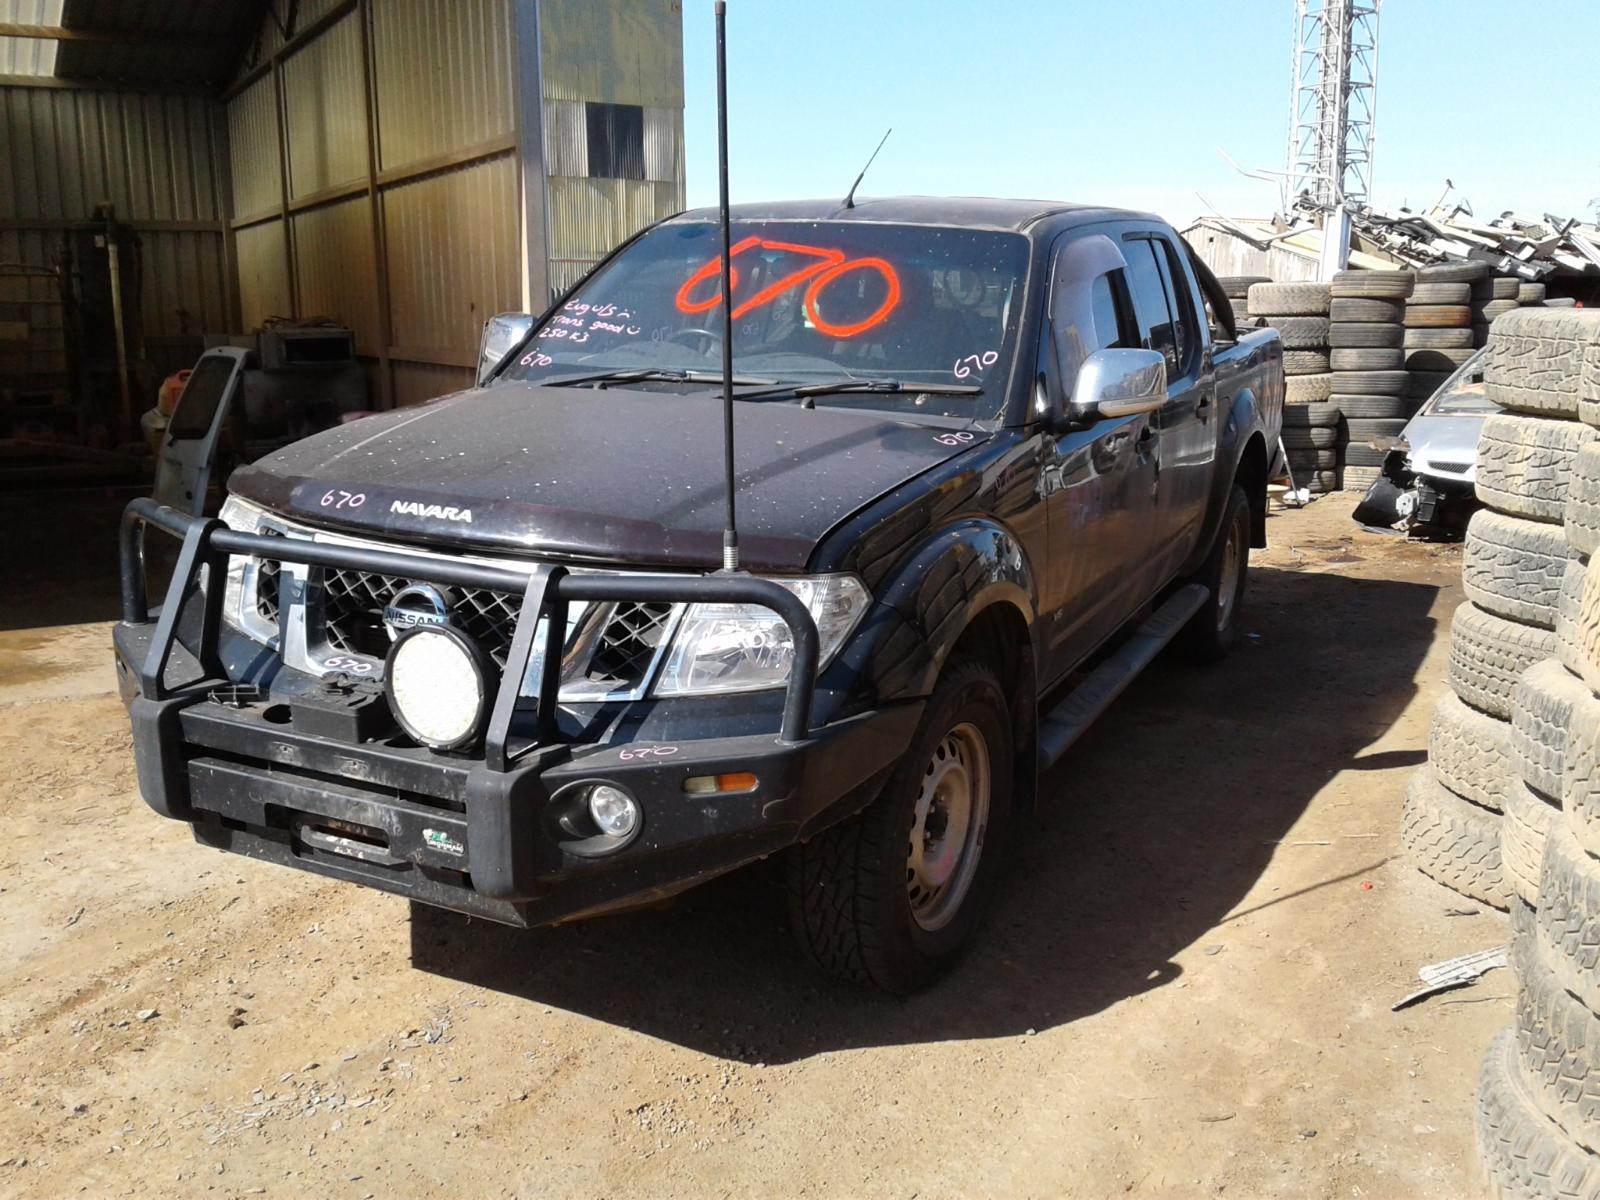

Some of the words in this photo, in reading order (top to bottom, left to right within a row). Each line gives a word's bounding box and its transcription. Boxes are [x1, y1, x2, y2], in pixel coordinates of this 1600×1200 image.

[675, 235, 900, 338] 670
[538, 327, 568, 339] 250
[589, 321, 625, 334] good
[520, 350, 553, 367] 670
[954, 350, 999, 379] 670
[932, 431, 975, 446] 670
[320, 489, 367, 508] 670
[390, 500, 473, 523] NAVARA
[386, 607, 439, 625] NISSAN
[324, 656, 372, 673] 670
[619, 745, 679, 760] 670
